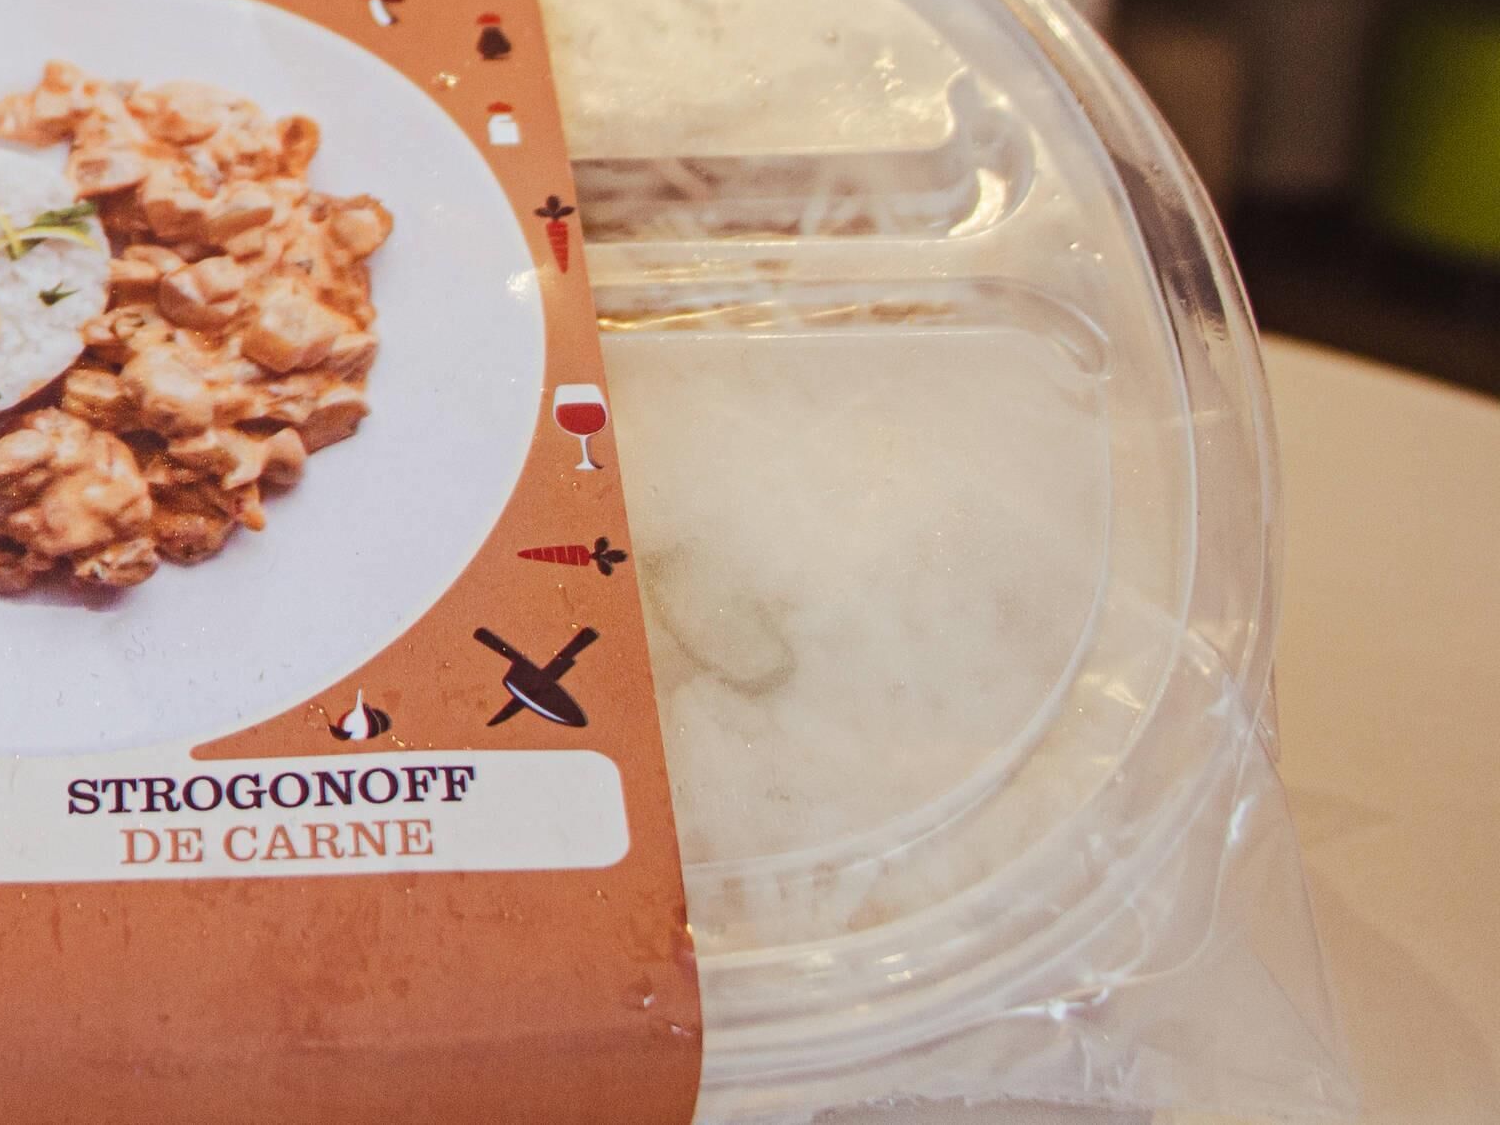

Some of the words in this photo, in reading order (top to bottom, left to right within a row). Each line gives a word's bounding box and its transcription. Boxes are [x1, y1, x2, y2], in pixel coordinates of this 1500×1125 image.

[67, 765, 476, 816] STROGONOFF
[120, 827, 203, 865] DE
[222, 819, 436, 861] CARNE
